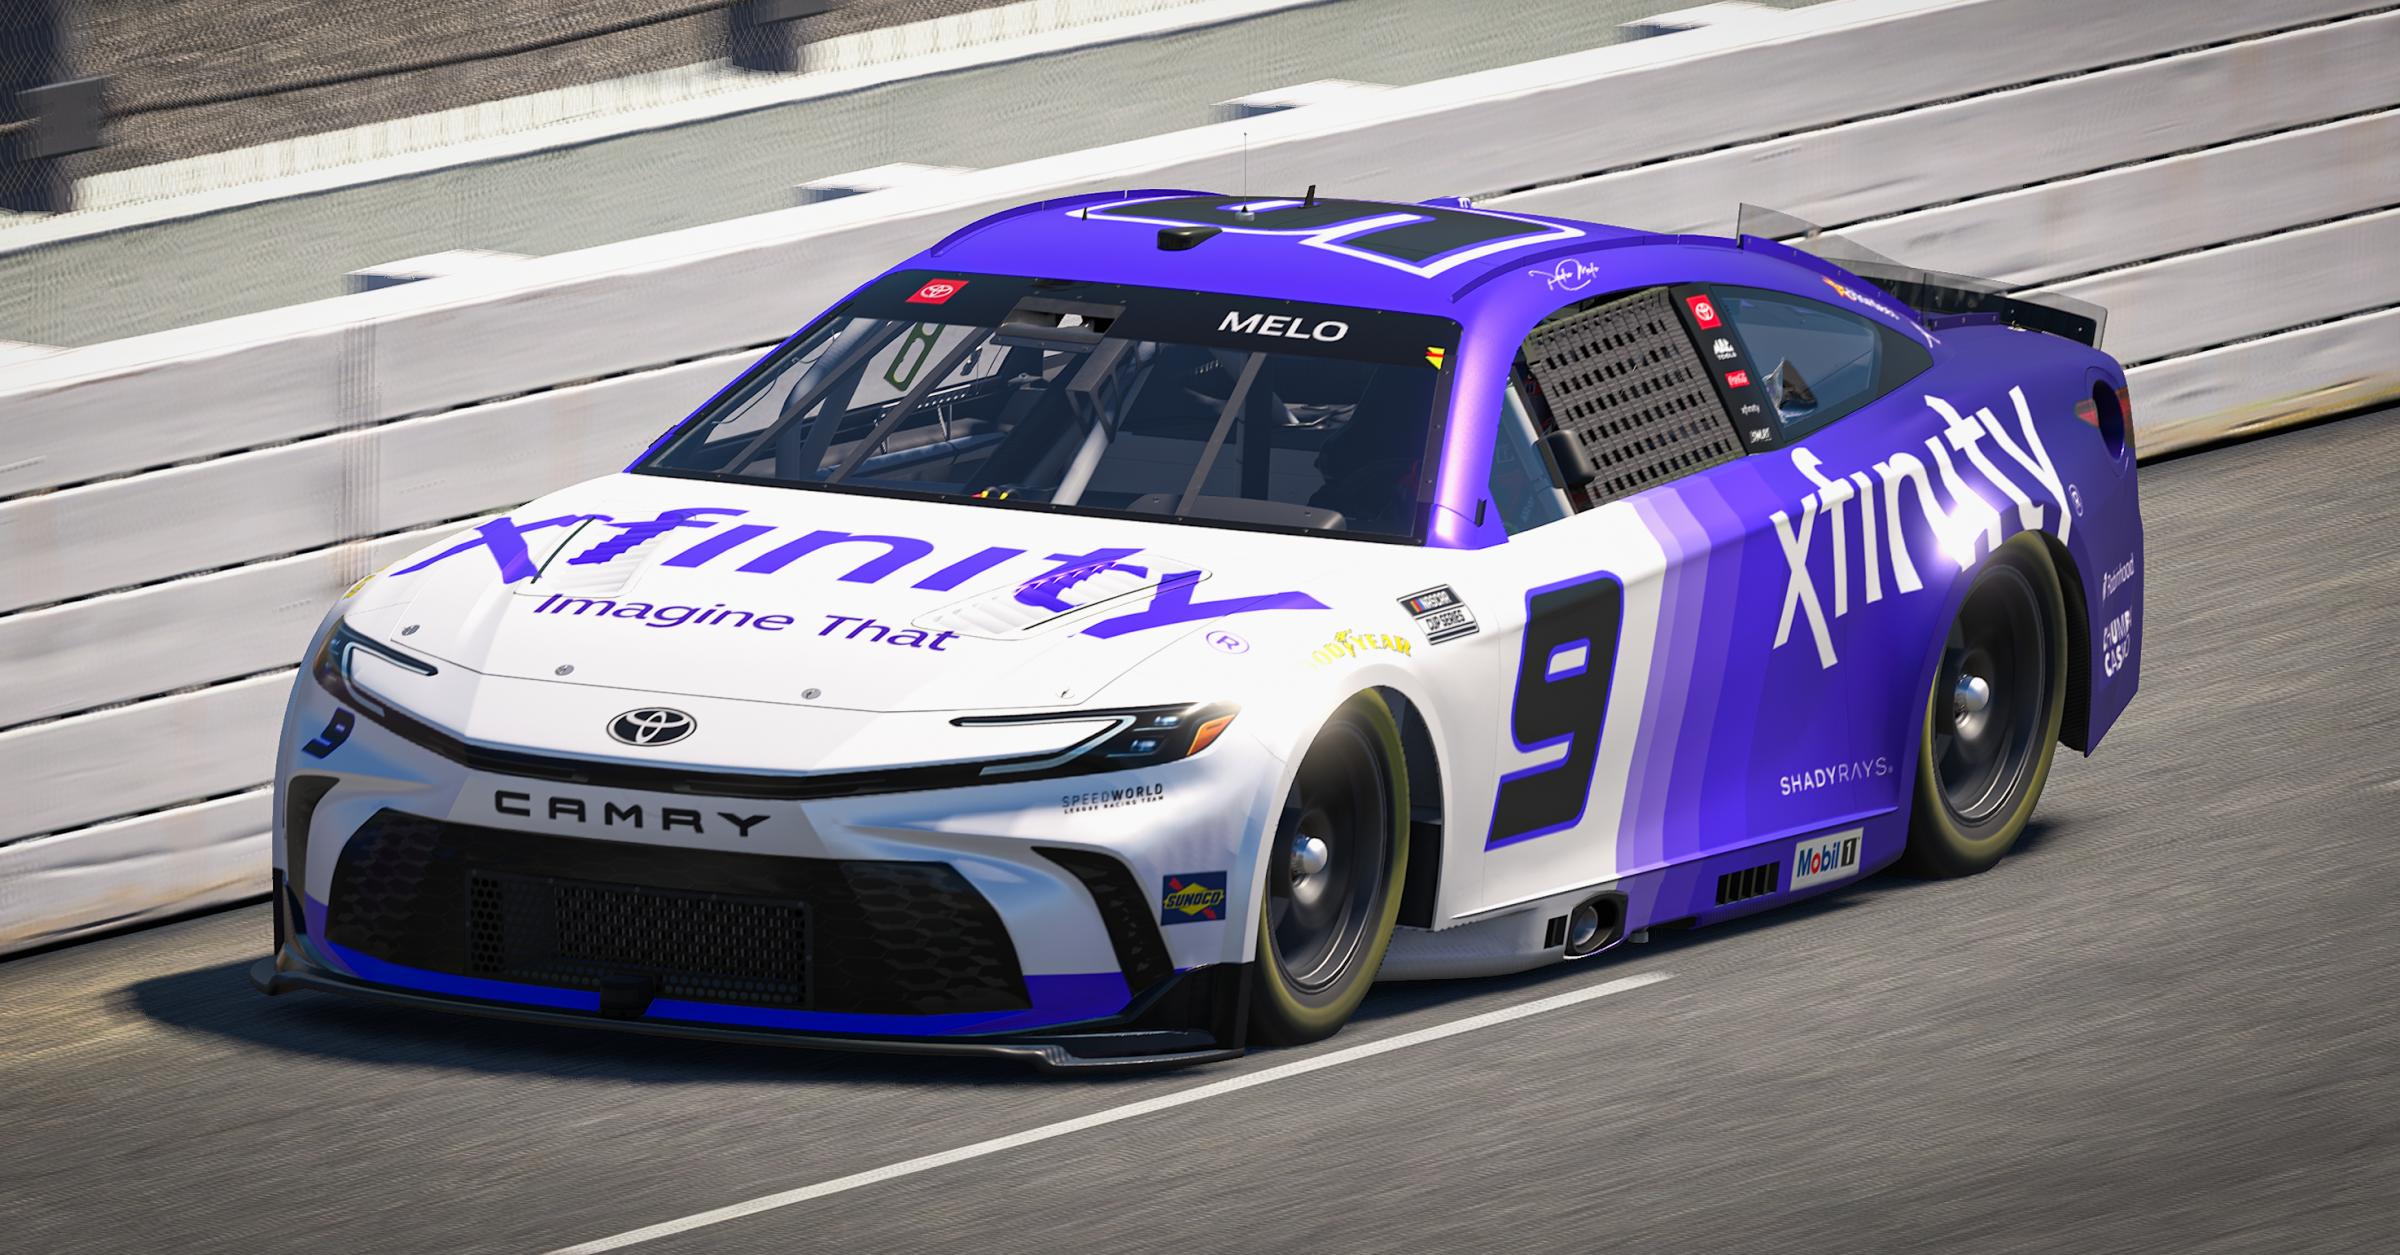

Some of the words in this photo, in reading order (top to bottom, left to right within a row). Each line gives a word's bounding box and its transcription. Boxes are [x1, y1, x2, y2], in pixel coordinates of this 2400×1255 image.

[1218, 311, 1349, 342] MELO
[1769, 385, 2071, 669] xfinity
[389, 507, 1332, 640] xfinity
[534, 593, 795, 628] Imagine
[818, 615, 960, 651] That
[1425, 615, 1441, 631] CUP
[1439, 609, 1465, 627] SERIES
[1308, 631, 1412, 665] ODYEAR
[1484, 570, 1624, 852] 9
[302, 707, 355, 760] 9
[494, 790, 771, 837] CAMRY
[1062, 783, 1164, 808] SPEEDWORLD
[1103, 800, 1137, 809] RACING
[1797, 841, 1841, 877] Mobil
[1841, 838, 1858, 867] 1
[1166, 891, 1221, 909] SUNOCO
